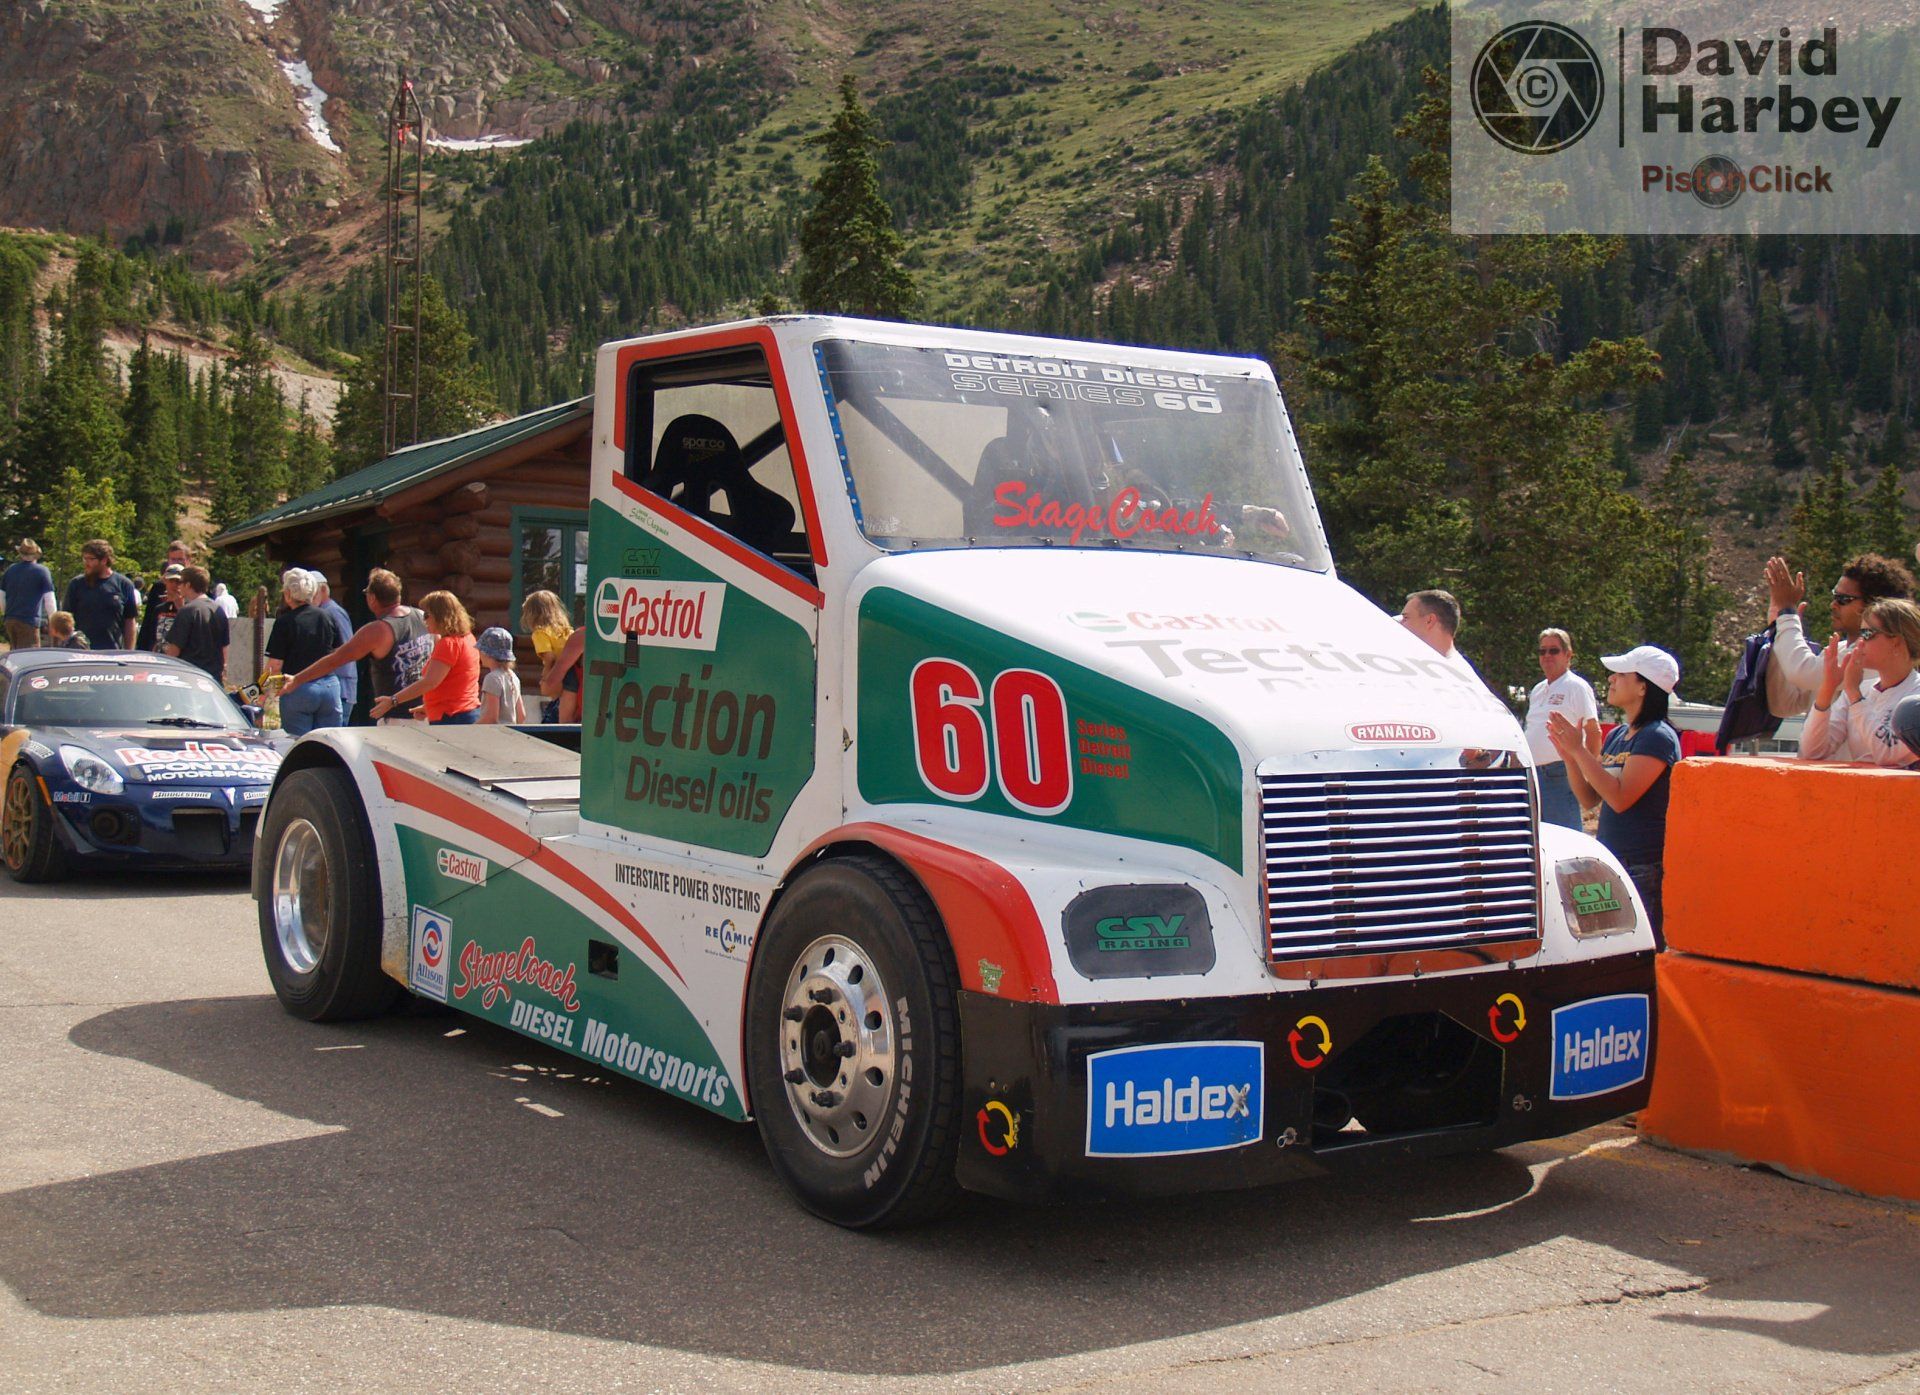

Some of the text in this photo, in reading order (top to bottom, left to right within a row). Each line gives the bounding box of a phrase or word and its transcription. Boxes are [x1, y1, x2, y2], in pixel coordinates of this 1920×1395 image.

[944, 354, 1216, 392] DETROIT DIESEL
[950, 371, 1222, 414] SERIES 60
[625, 567, 658, 575] RACING
[620, 586, 706, 640] Castrol
[1126, 610, 1290, 634] Castrol
[1104, 638, 1473, 683] Tection
[58, 674, 133, 685] FORMULA
[588, 660, 776, 760] Tection
[910, 657, 1073, 816] 60
[1076, 719, 1127, 740] Series
[1356, 724, 1432, 740] RYANATOR
[1078, 738, 1131, 760] Detroit
[143, 763, 280, 774] PONTIAC
[1080, 757, 1130, 779] Diesel
[625, 756, 774, 823] Diesel oils
[448, 853, 481, 883] Castrol
[615, 863, 761, 914] INTERSTATE POWER SYSTEMS
[1573, 881, 1612, 904] CSV
[1579, 900, 1618, 914] RACING
[1096, 914, 1185, 939] CSV
[1104, 938, 1184, 949] RACING
[416, 963, 444, 985] Allison
[453, 936, 580, 1012] StageCoach
[510, 999, 730, 1107] DIESEL Motorsports
[1563, 1024, 1641, 1074] Haldex
[863, 996, 913, 1190] MICHELIN
[1105, 1075, 1250, 1128] Haldex
